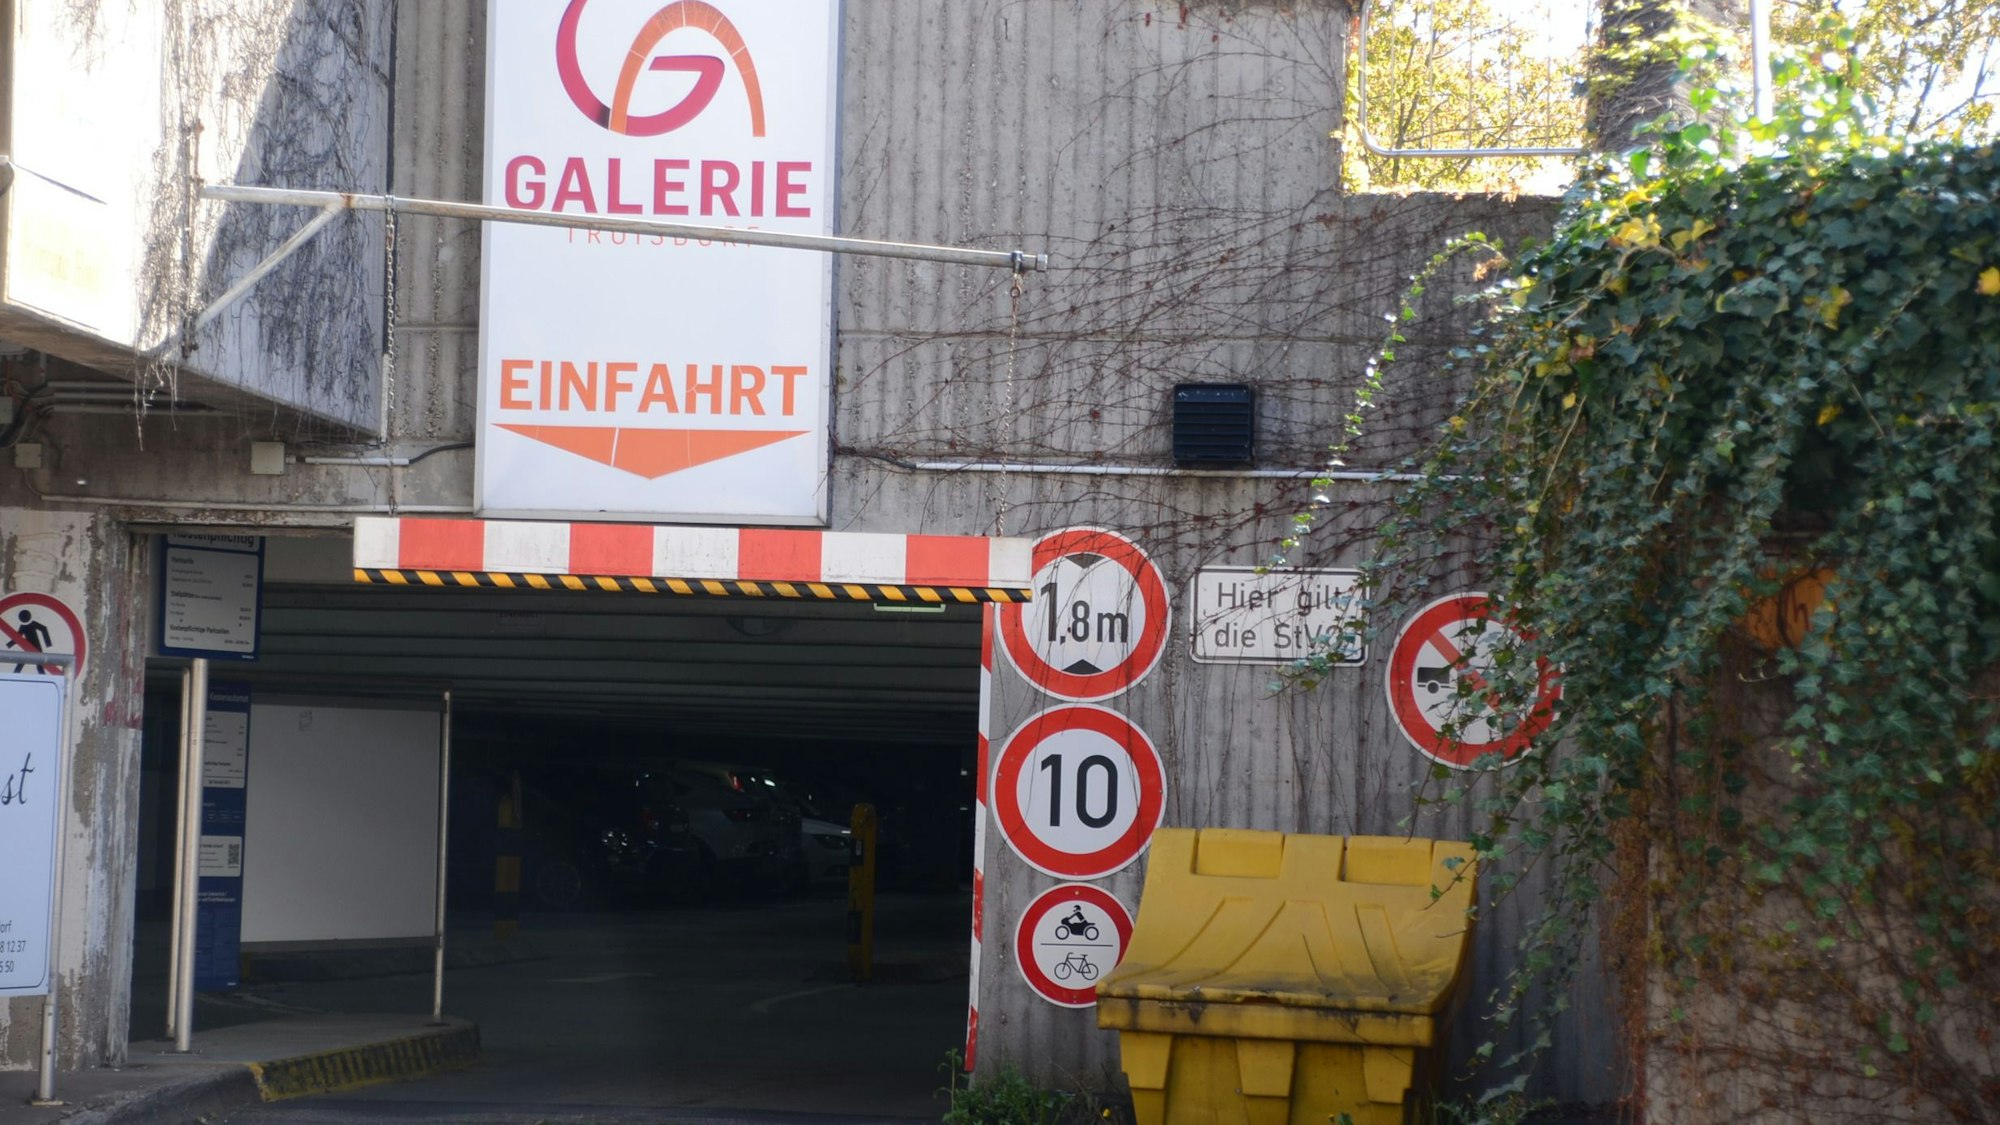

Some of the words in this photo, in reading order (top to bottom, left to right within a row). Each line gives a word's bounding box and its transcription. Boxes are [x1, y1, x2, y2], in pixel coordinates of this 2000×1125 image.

[504, 155, 812, 218] GALERIE
[499, 359, 808, 417] EINFAHRT
[1217, 582, 1272, 609] Hier
[1297, 584, 1341, 616] gilt
[1214, 622, 1256, 648] die
[1040, 753, 1118, 828] 10
